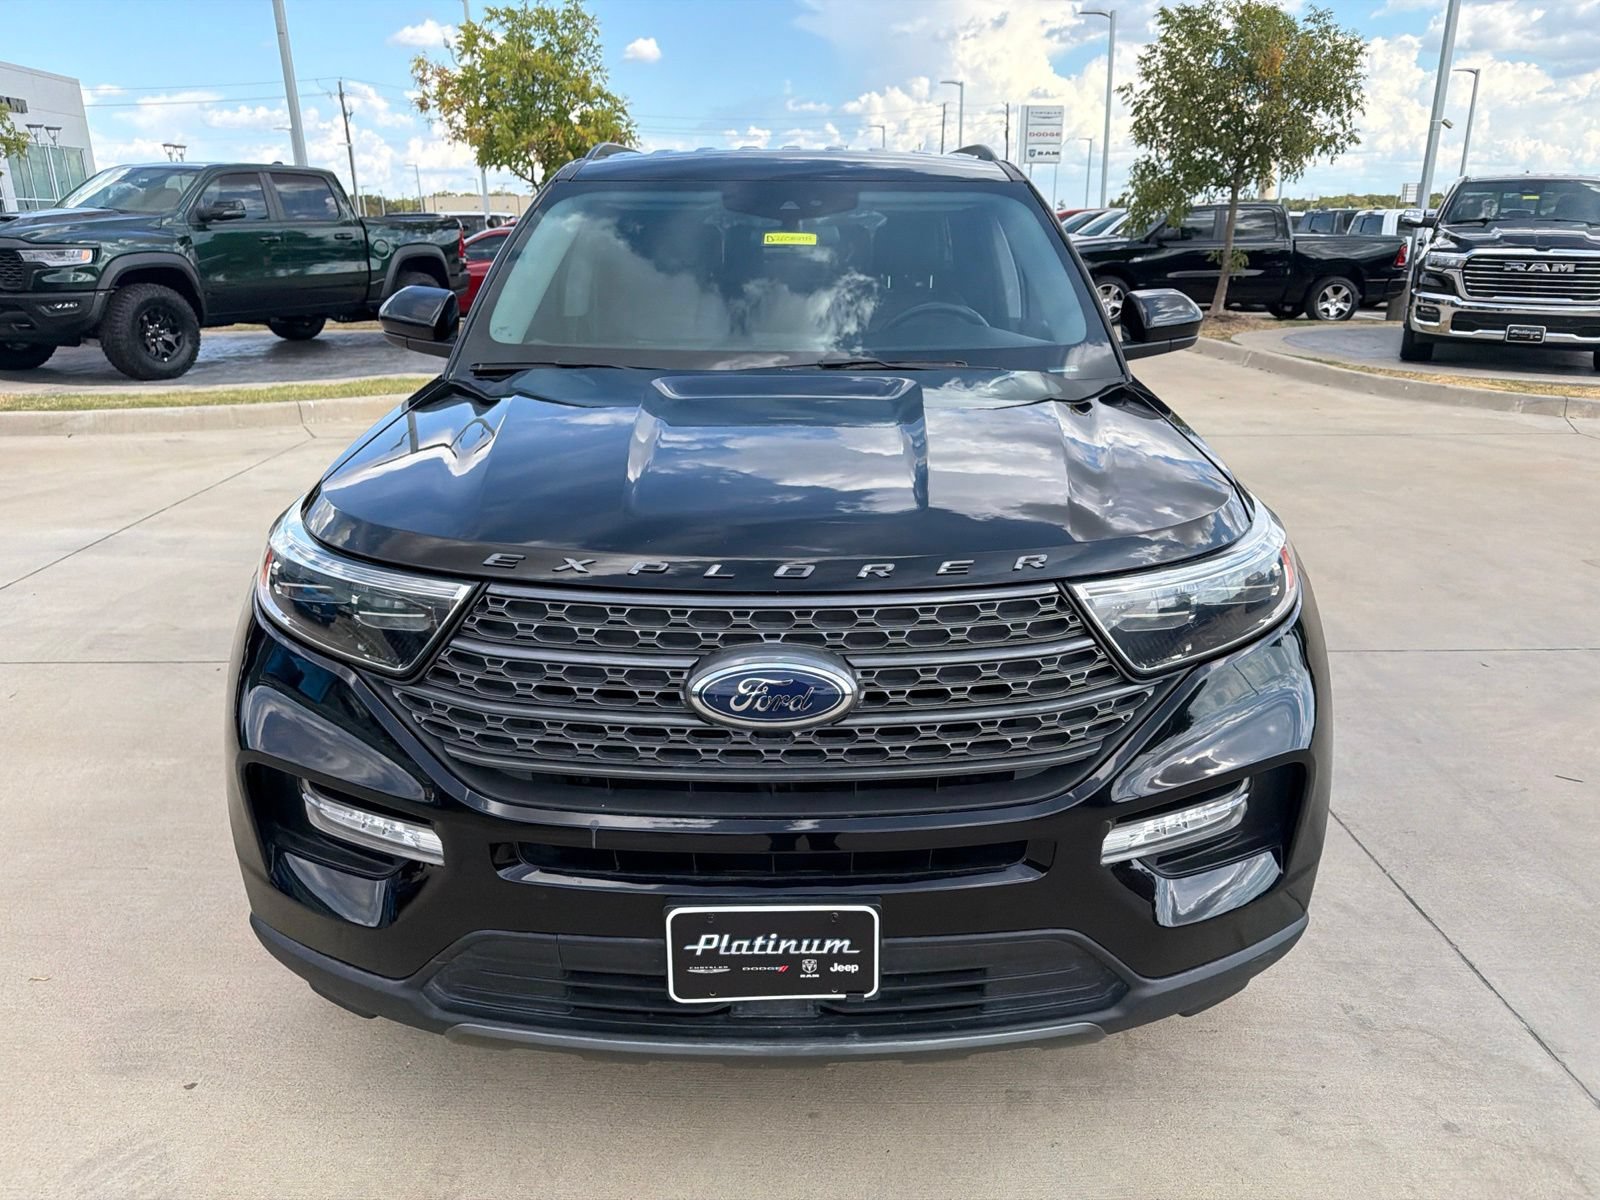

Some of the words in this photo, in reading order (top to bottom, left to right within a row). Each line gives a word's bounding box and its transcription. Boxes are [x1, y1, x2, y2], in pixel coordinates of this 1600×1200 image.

[1503, 262, 1576, 272] RAM
[482, 553, 1048, 578] EXPLORER
[729, 677, 815, 712] Ford
[684, 933, 861, 955] Platinum
[829, 962, 859, 974] Jeep
